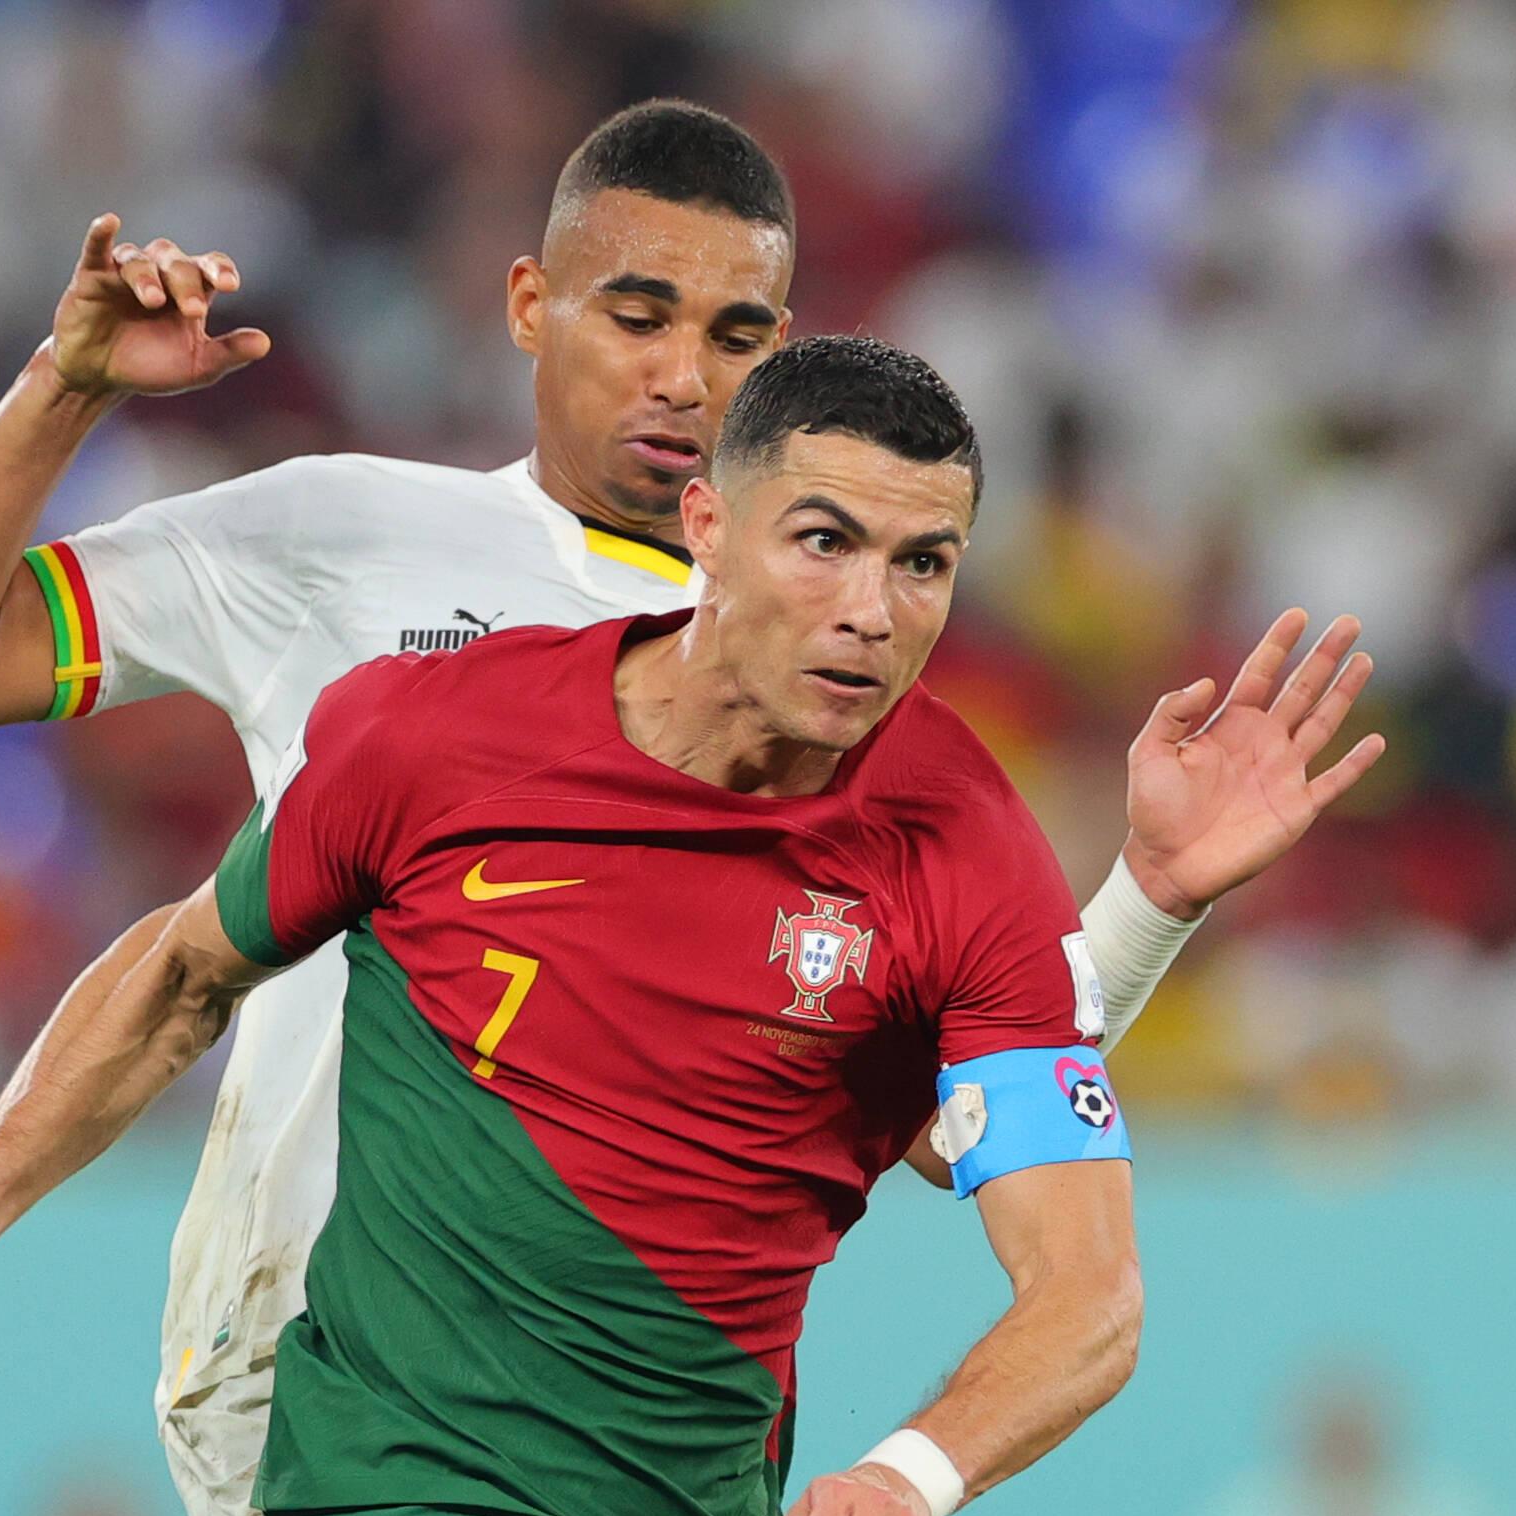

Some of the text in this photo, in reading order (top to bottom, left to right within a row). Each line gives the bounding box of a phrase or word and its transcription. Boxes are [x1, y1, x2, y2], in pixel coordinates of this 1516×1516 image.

[471, 948, 540, 1080] 7
[746, 1022, 761, 1037] 24
[762, 1026, 819, 1047] NOVEMBRO
[778, 1043, 807, 1057] DO
